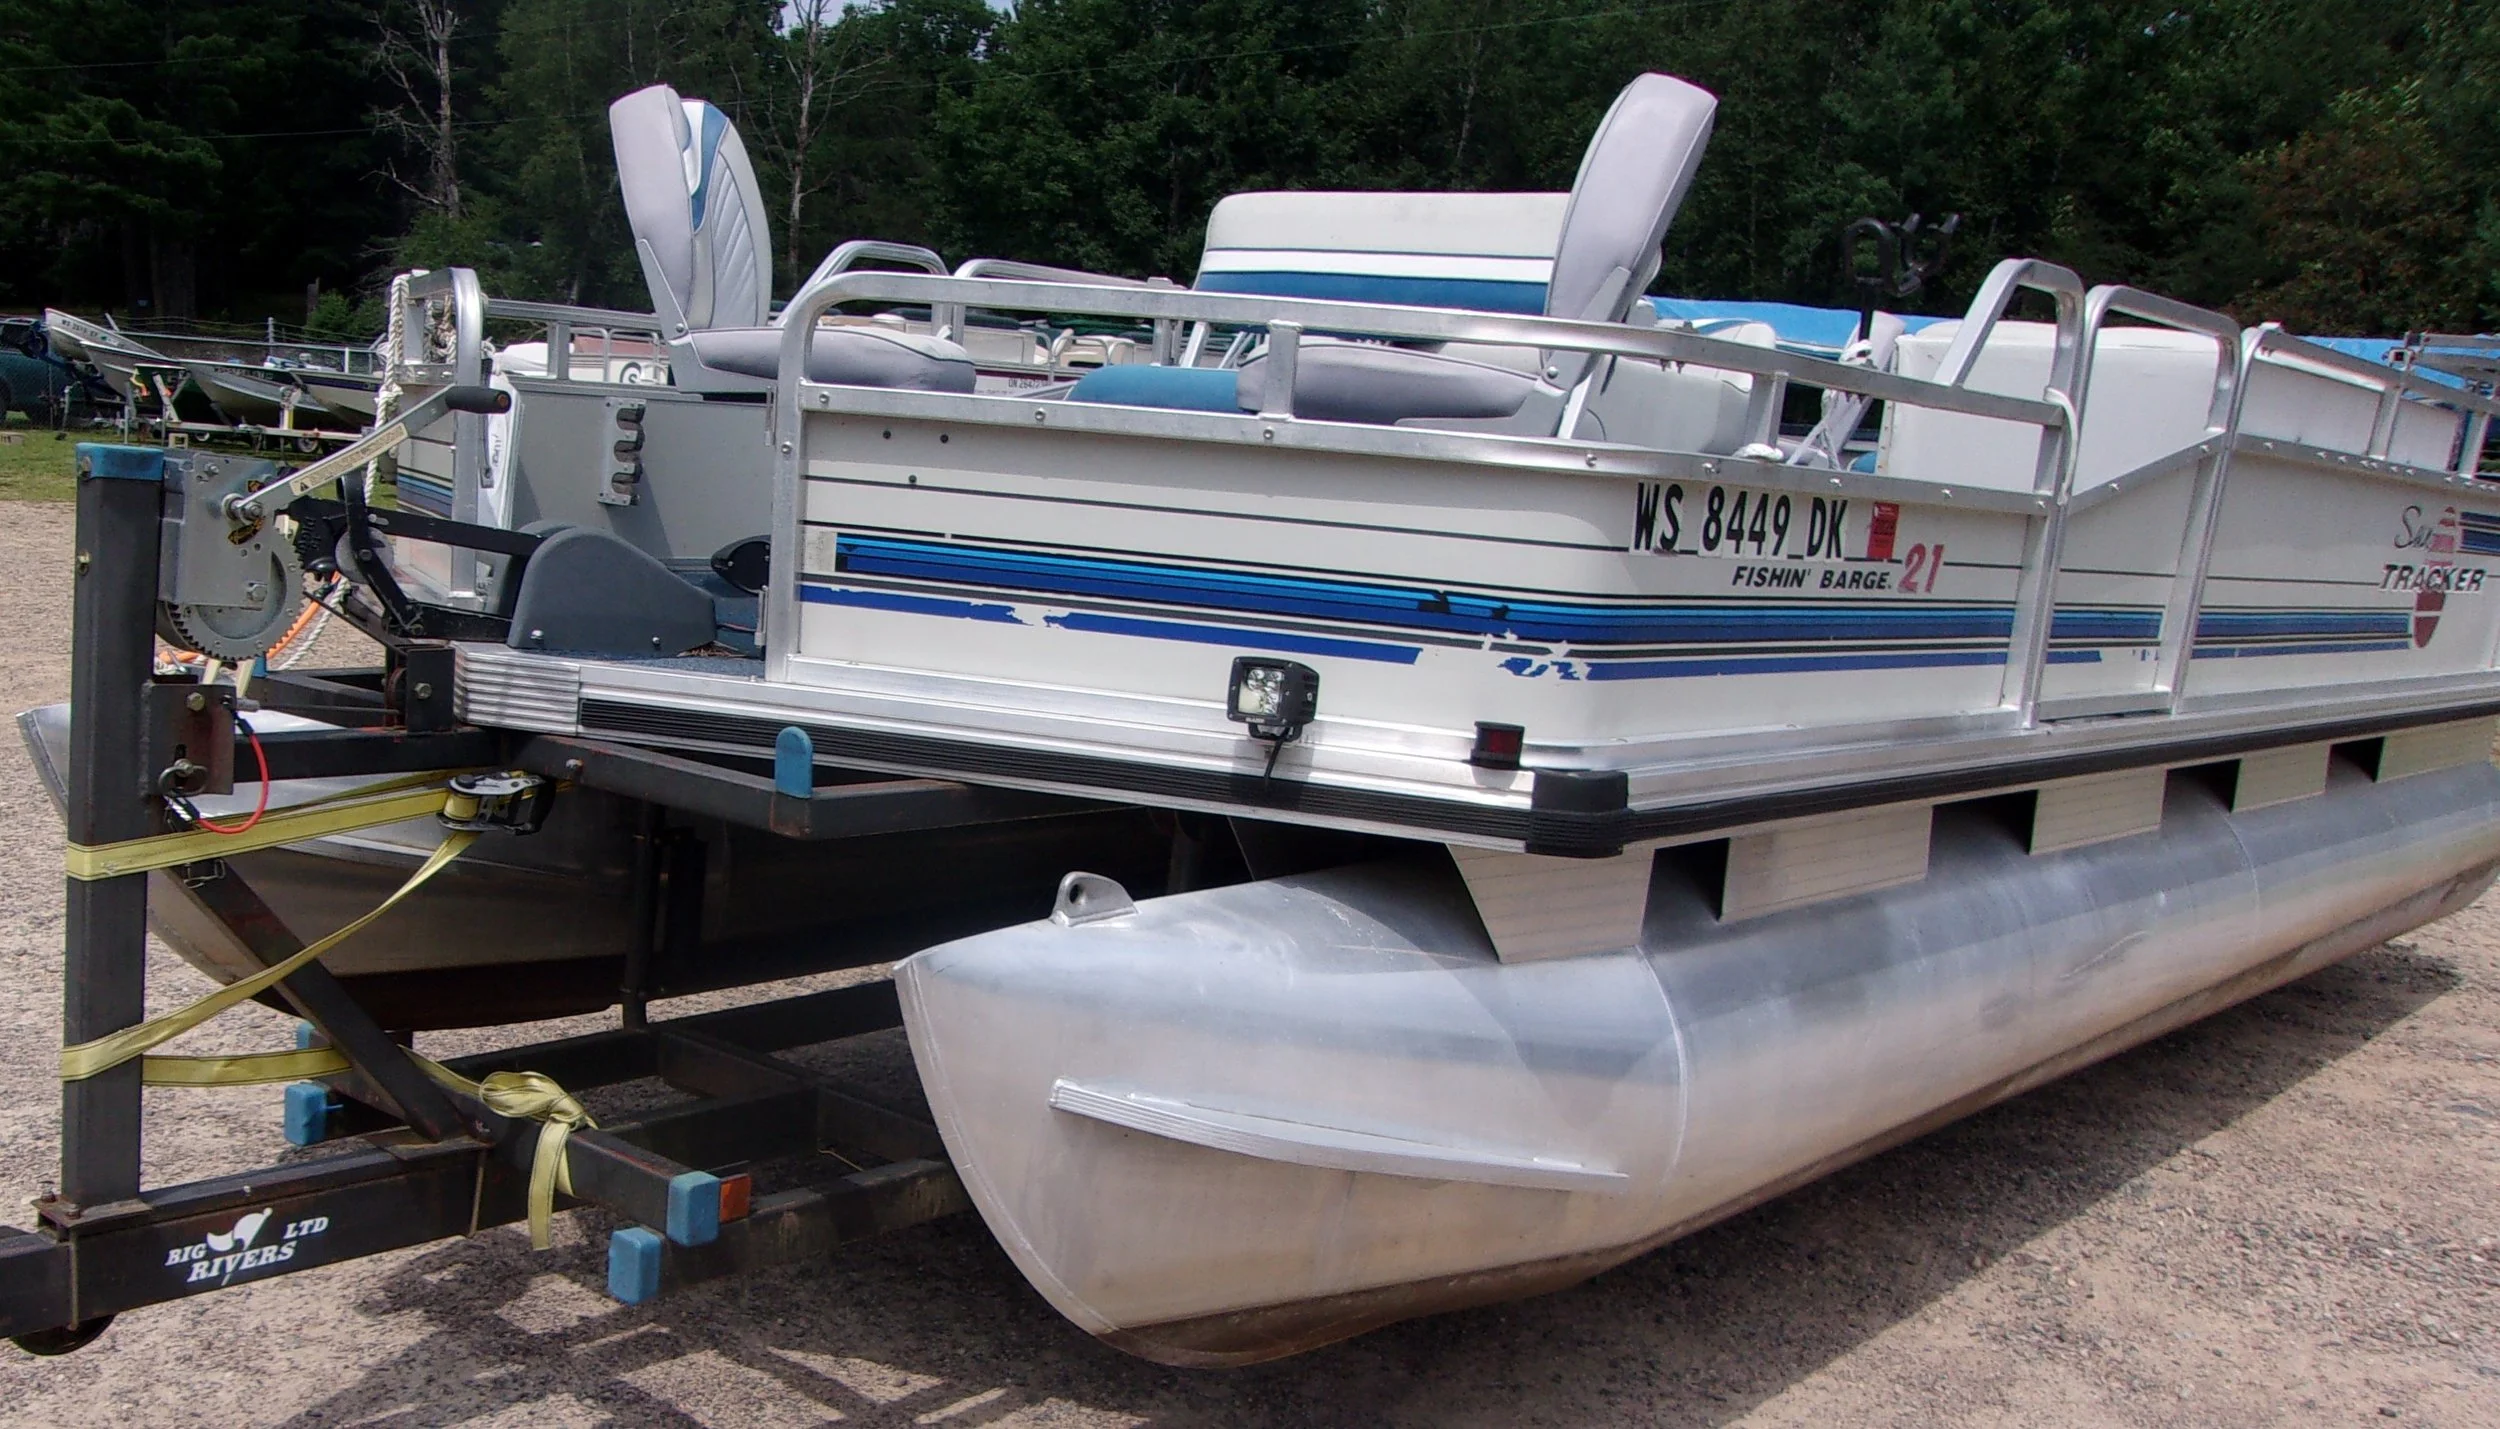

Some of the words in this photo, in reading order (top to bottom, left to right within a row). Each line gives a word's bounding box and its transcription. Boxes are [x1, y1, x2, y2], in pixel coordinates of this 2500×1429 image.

[1633, 482, 1684, 552] WS
[1702, 486, 1791, 556] 8449
[1806, 497, 1849, 560] DK
[1732, 565, 1811, 589] FISHIN'
[1897, 543, 1945, 594] 21
[2379, 564, 2487, 592] TRACKER
[164, 1242, 208, 1267] BIG
[283, 1216, 330, 1240] LTD
[186, 1240, 298, 1286] RIVERS
